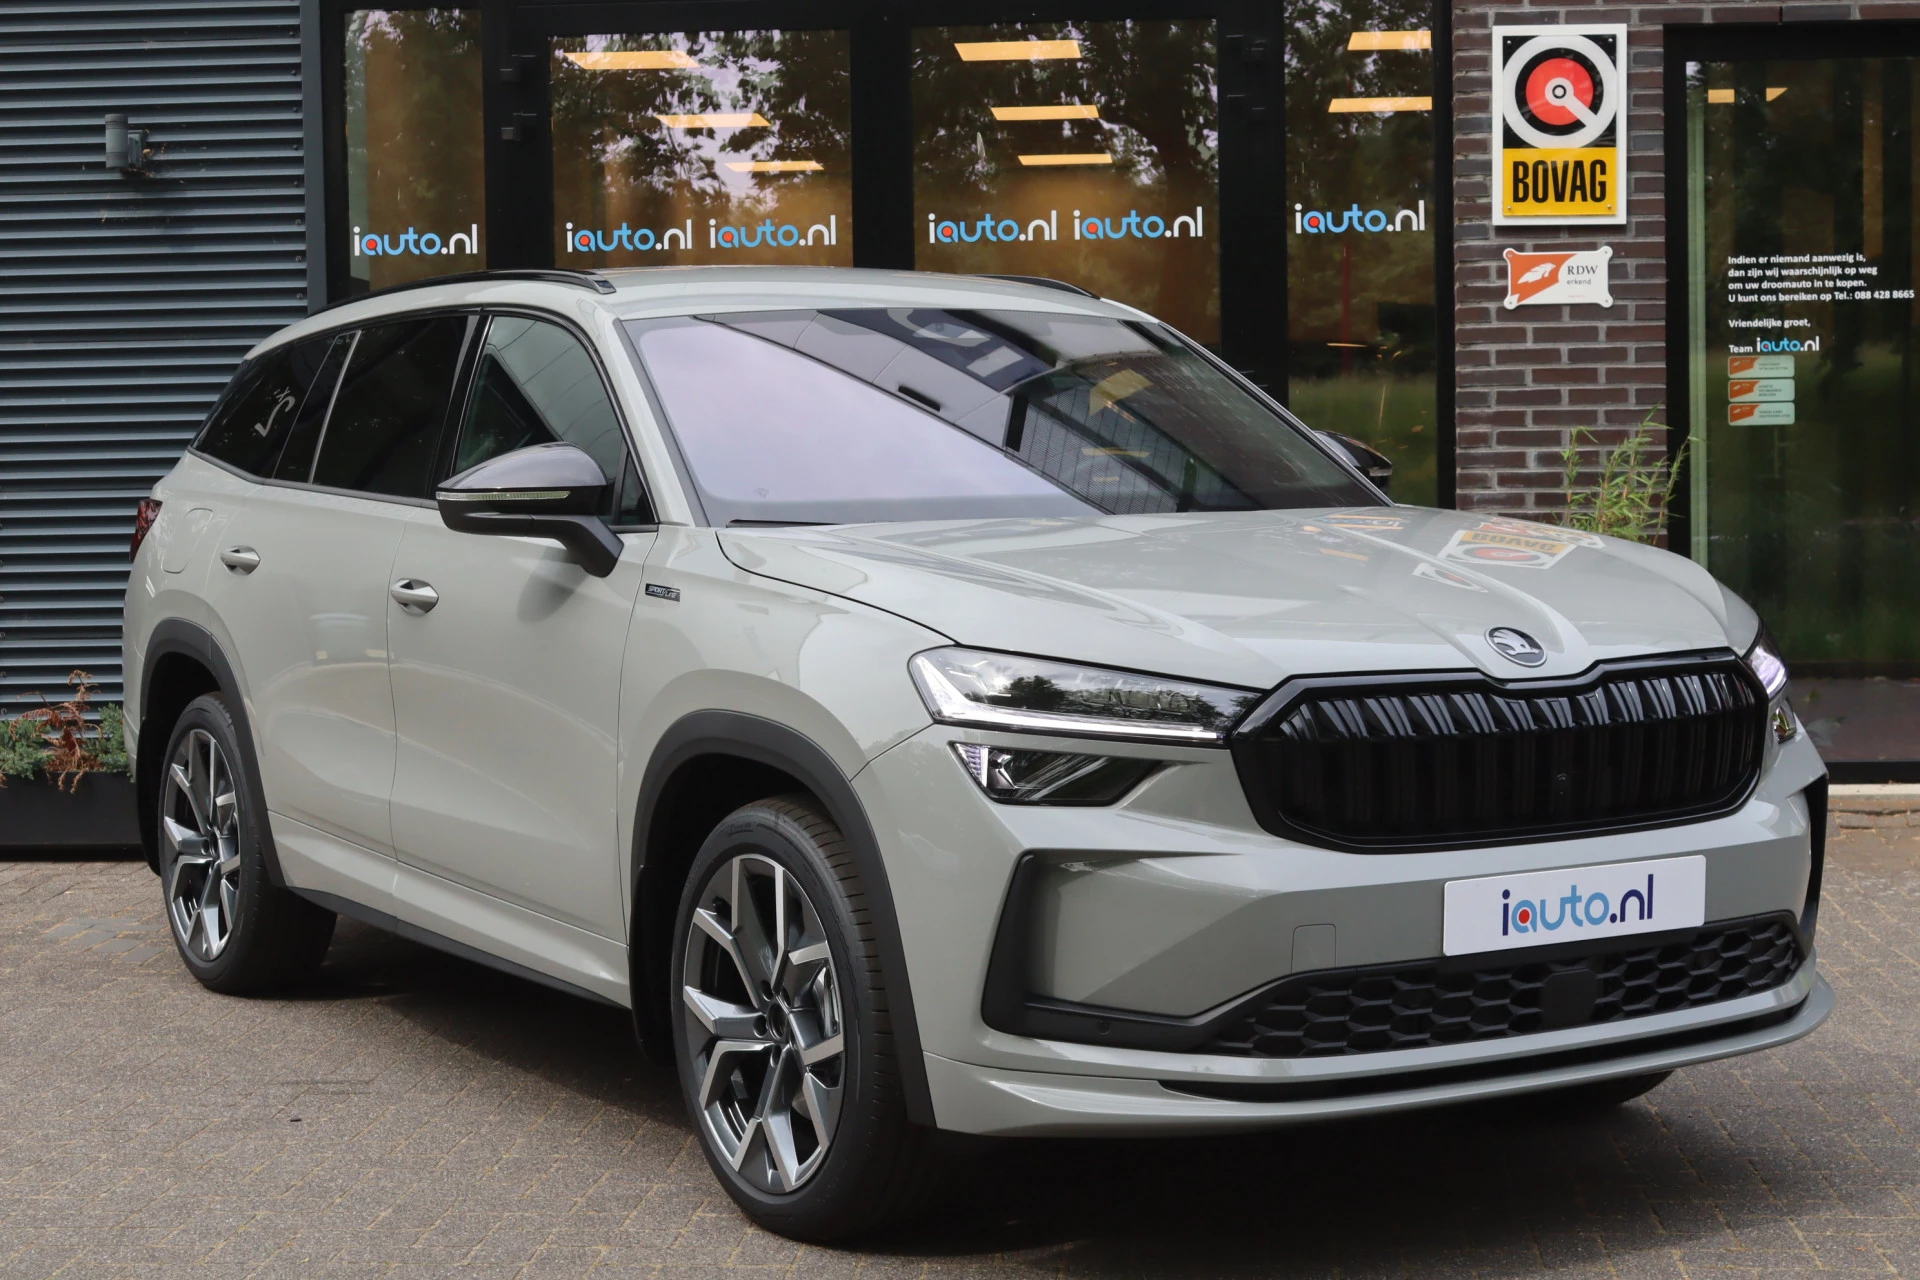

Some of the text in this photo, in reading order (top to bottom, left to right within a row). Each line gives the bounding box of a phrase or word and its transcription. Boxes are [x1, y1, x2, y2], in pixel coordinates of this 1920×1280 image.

[1512, 159, 1607, 204] BOVAG
[928, 206, 1203, 244] iauto.nl iauto.nl
[1294, 200, 1425, 235] iauto.nl
[353, 223, 479, 257] iauto.nl
[566, 214, 837, 253] iauto.nl iauto.nl
[1727, 252, 1866, 264] Indien er niemand aanwezig is,
[1567, 264, 1599, 276] RDW
[1727, 266, 1878, 279] dan zijn wij waarschijnlijk op weg
[1728, 278, 1867, 290] om uw droomauto in te kopen.
[1728, 294, 1736, 302] U
[1737, 293, 1759, 302] kunt
[1760, 294, 1777, 302] ons
[1778, 291, 1818, 301] bereiken
[1819, 293, 1832, 302] op
[1854, 290, 1872, 300] 088
[1873, 289, 1891, 299] 428
[1892, 289, 1915, 299] 8665
[1728, 318, 1811, 329] Vriendelijke groet,
[1728, 335, 1820, 353] Team iauto.nl
[1502, 873, 1654, 936] iauto.nl
